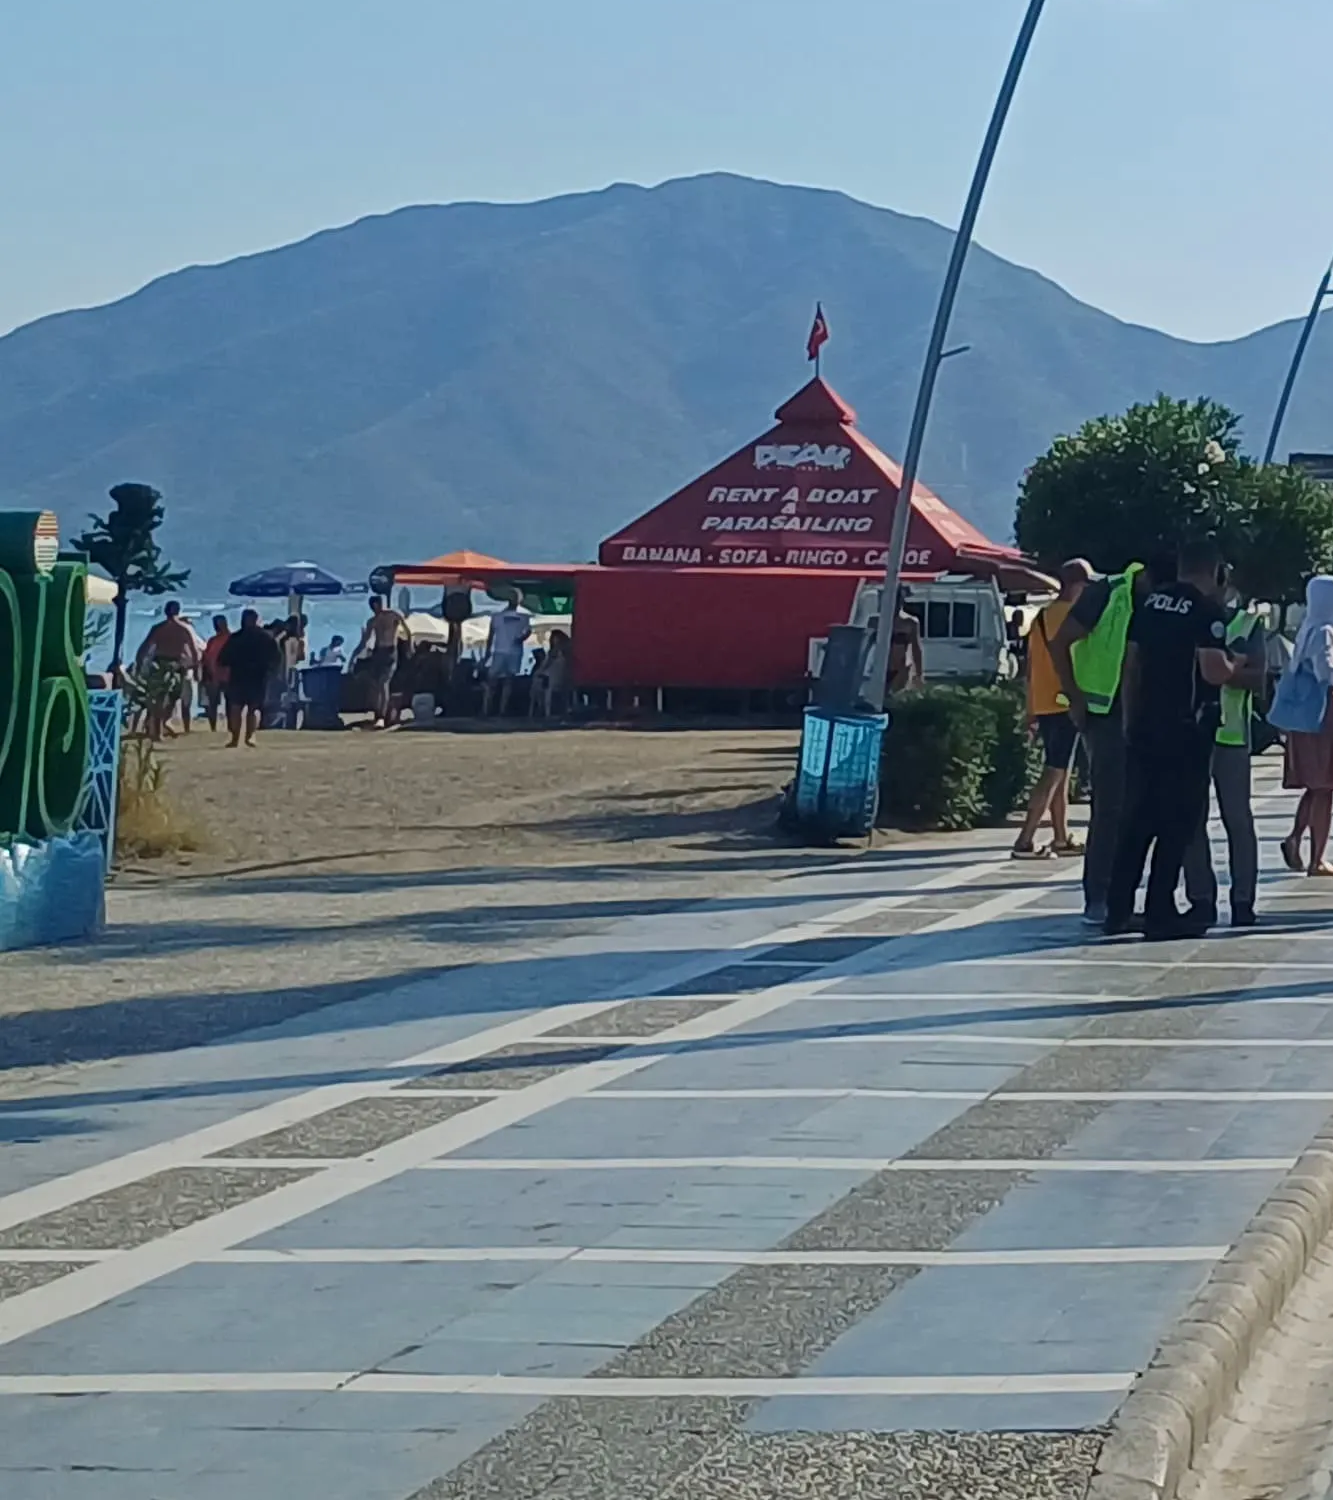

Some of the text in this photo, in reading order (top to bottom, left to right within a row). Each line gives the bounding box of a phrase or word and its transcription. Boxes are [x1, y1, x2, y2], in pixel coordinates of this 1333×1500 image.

[707, 486, 879, 504] RENT A BOAT
[701, 515, 873, 532] PARASAILING
[622, 546, 932, 566] BANANA SOFA RINGO CAOE
